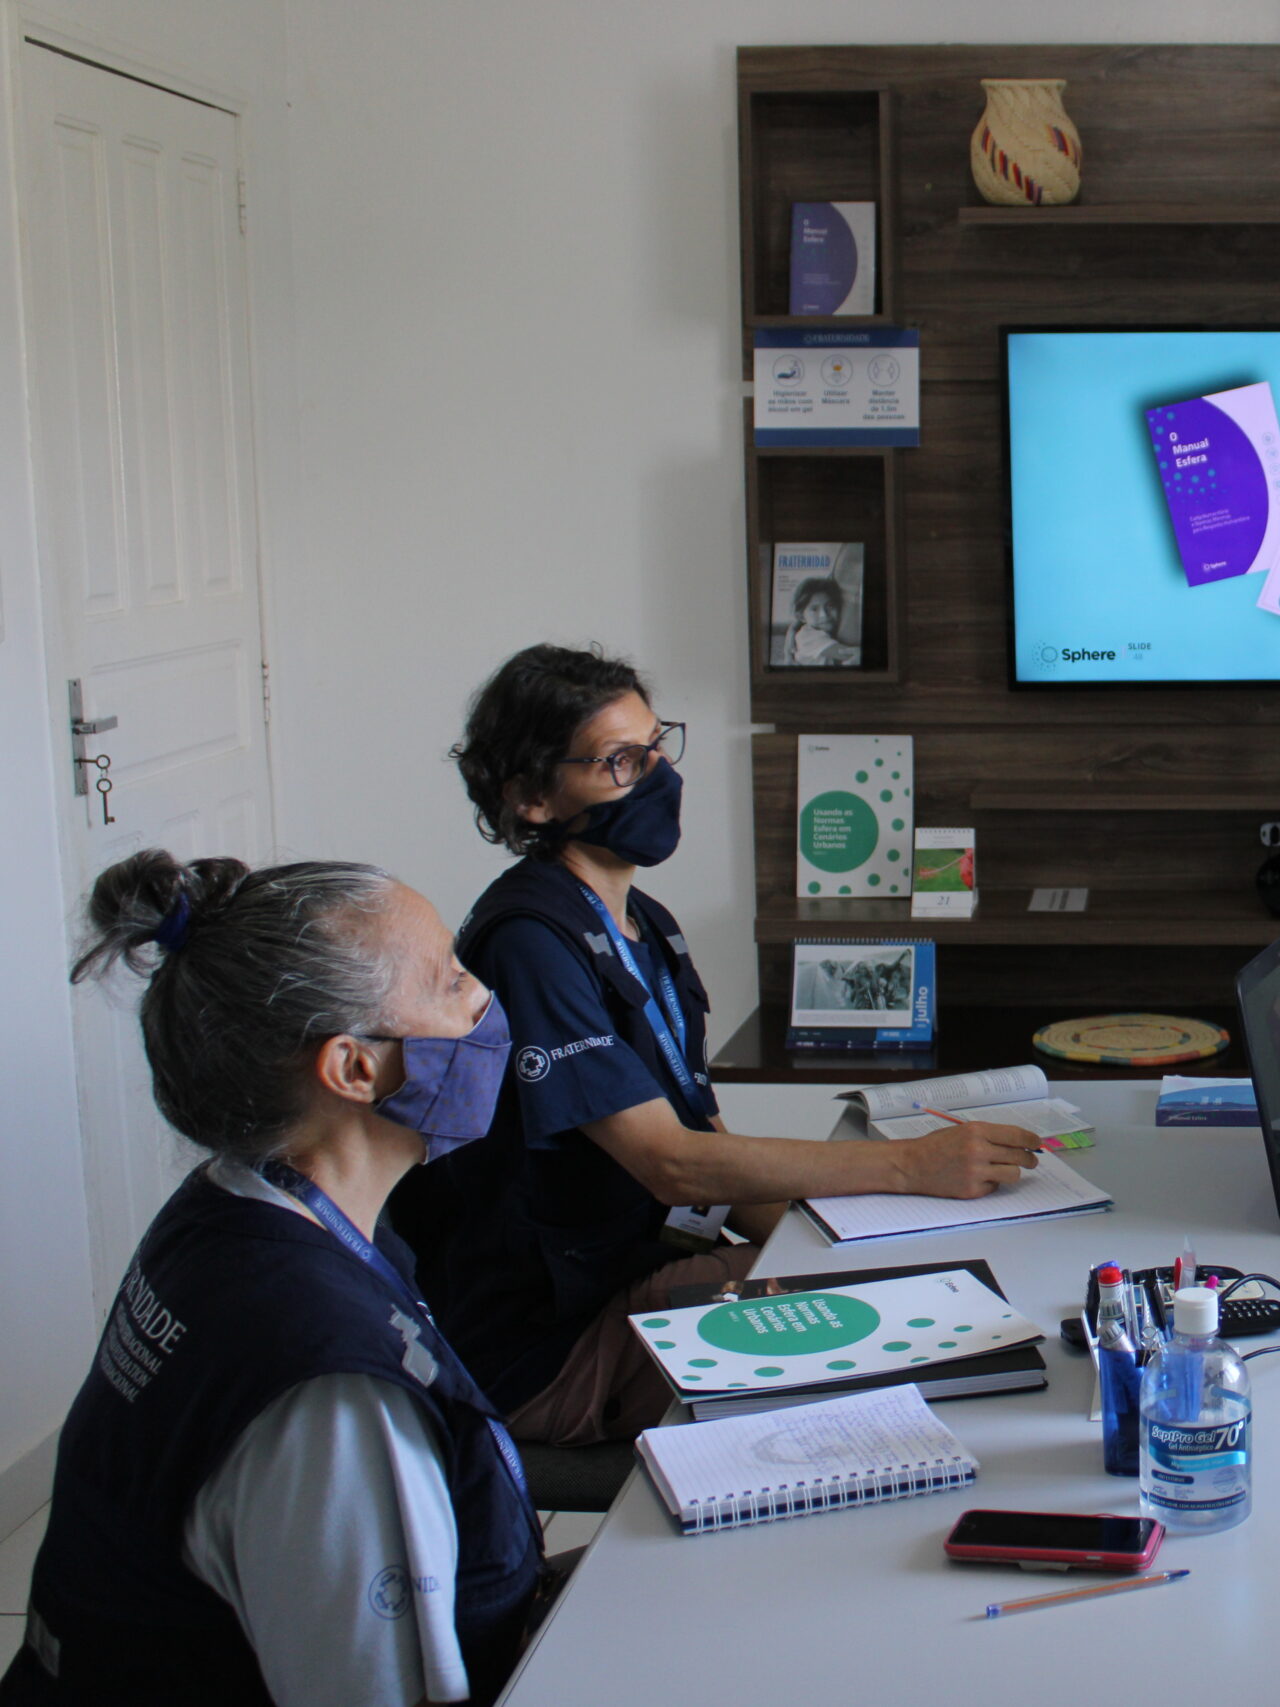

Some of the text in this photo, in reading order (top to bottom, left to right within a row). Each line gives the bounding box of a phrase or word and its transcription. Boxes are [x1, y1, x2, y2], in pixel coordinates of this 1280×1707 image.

[1169, 432, 1178, 442] O
[1172, 438, 1209, 455] Manual
[1175, 454, 1208, 468] Esfera
[1128, 642, 1152, 650] SLIDE
[1061, 648, 1116, 663] Sphere
[813, 808, 843, 817] Usando
[813, 816, 844, 824] Normas
[813, 824, 837, 833] Esfera
[813, 832, 847, 841] Cenários
[813, 841, 846, 849] Urbanos
[914, 986, 930, 1024] julho
[760, 1306, 787, 1332] Cenários
[777, 1304, 807, 1332] Esfera em
[794, 1301, 821, 1325] Normas
[812, 1299, 844, 1328] Usando as
[742, 1308, 768, 1334] Urbanos
[1152, 1425, 1193, 1443] SeptPro
[1195, 1431, 1215, 1444] Gel
